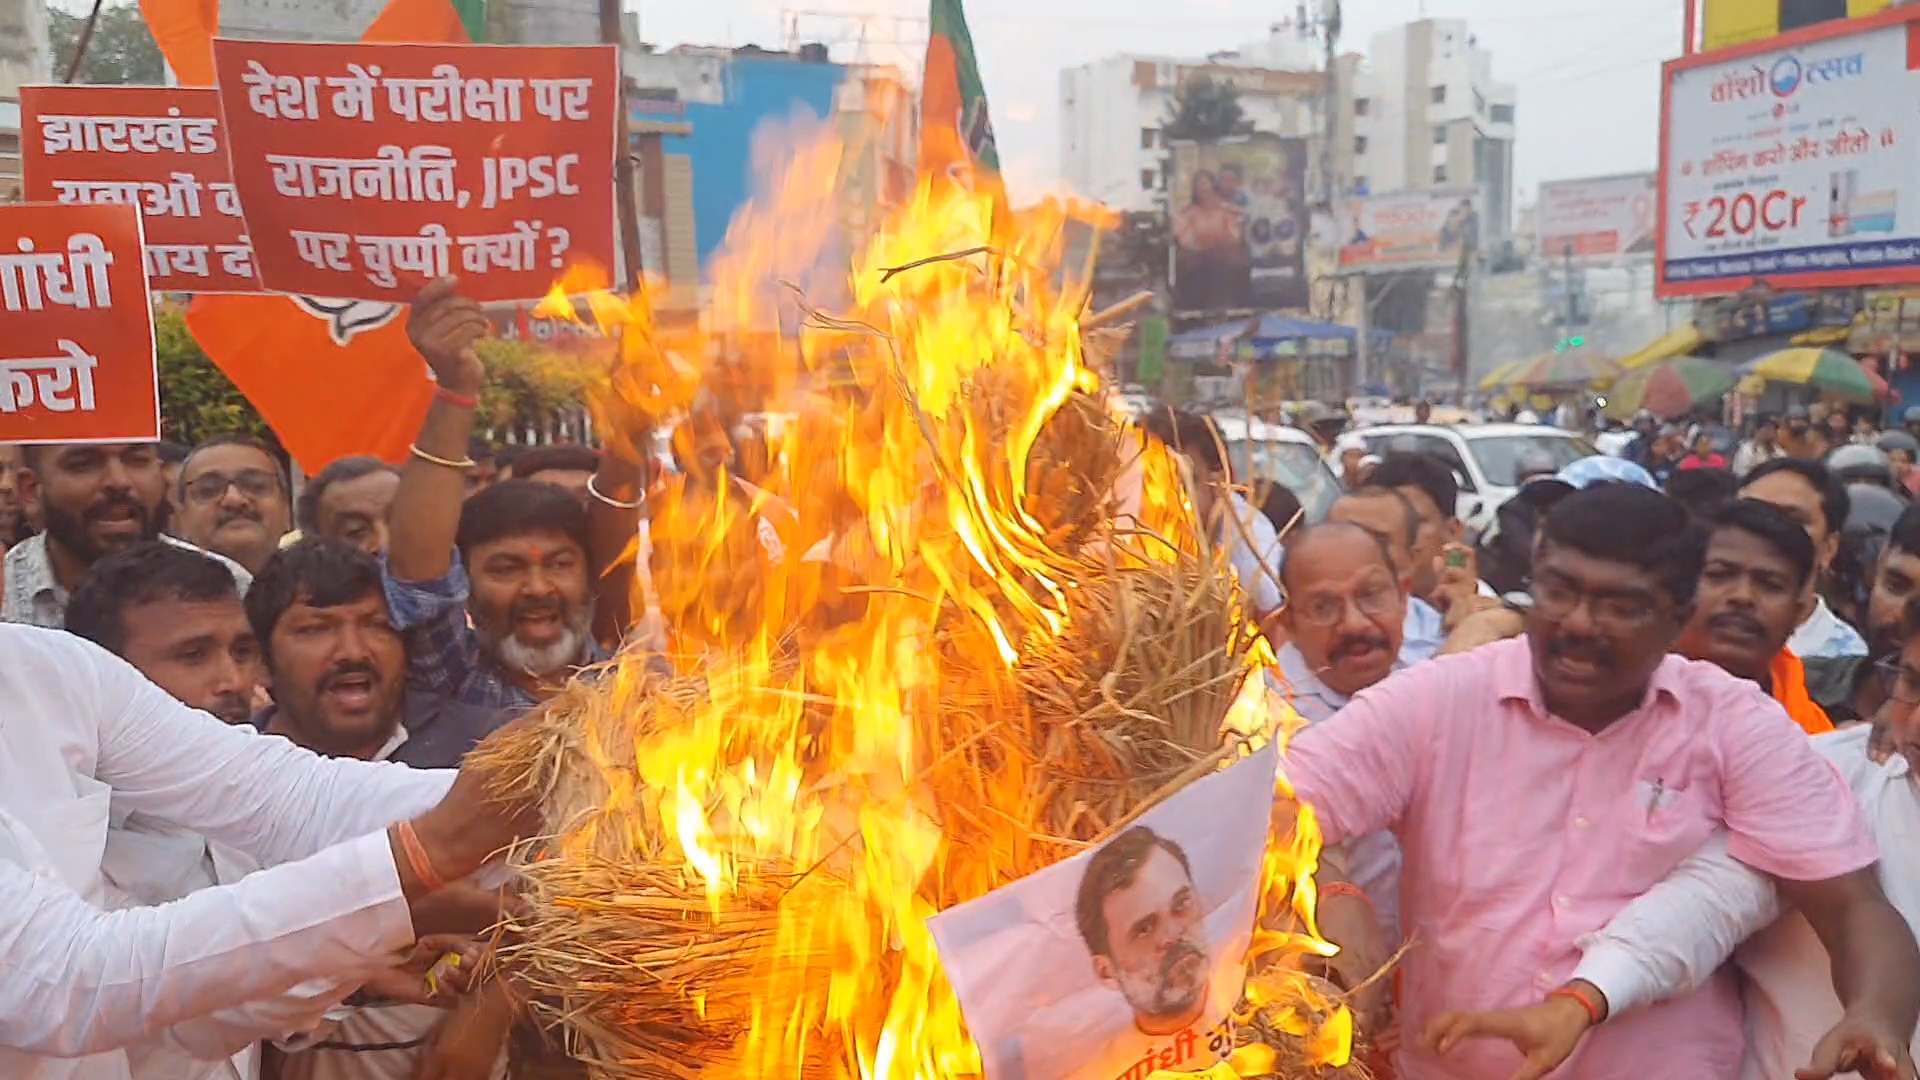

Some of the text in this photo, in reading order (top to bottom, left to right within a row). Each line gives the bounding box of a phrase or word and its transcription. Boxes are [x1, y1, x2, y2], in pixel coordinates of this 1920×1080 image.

[242, 60, 593, 123] देश में परीक्षा पर
[37, 106, 218, 155] झारखंड
[266, 145, 581, 209] राजनीति, JPSC
[289, 228, 351, 272] पर
[355, 223, 453, 289] चुप्पी
[457, 220, 543, 274] क्यों
